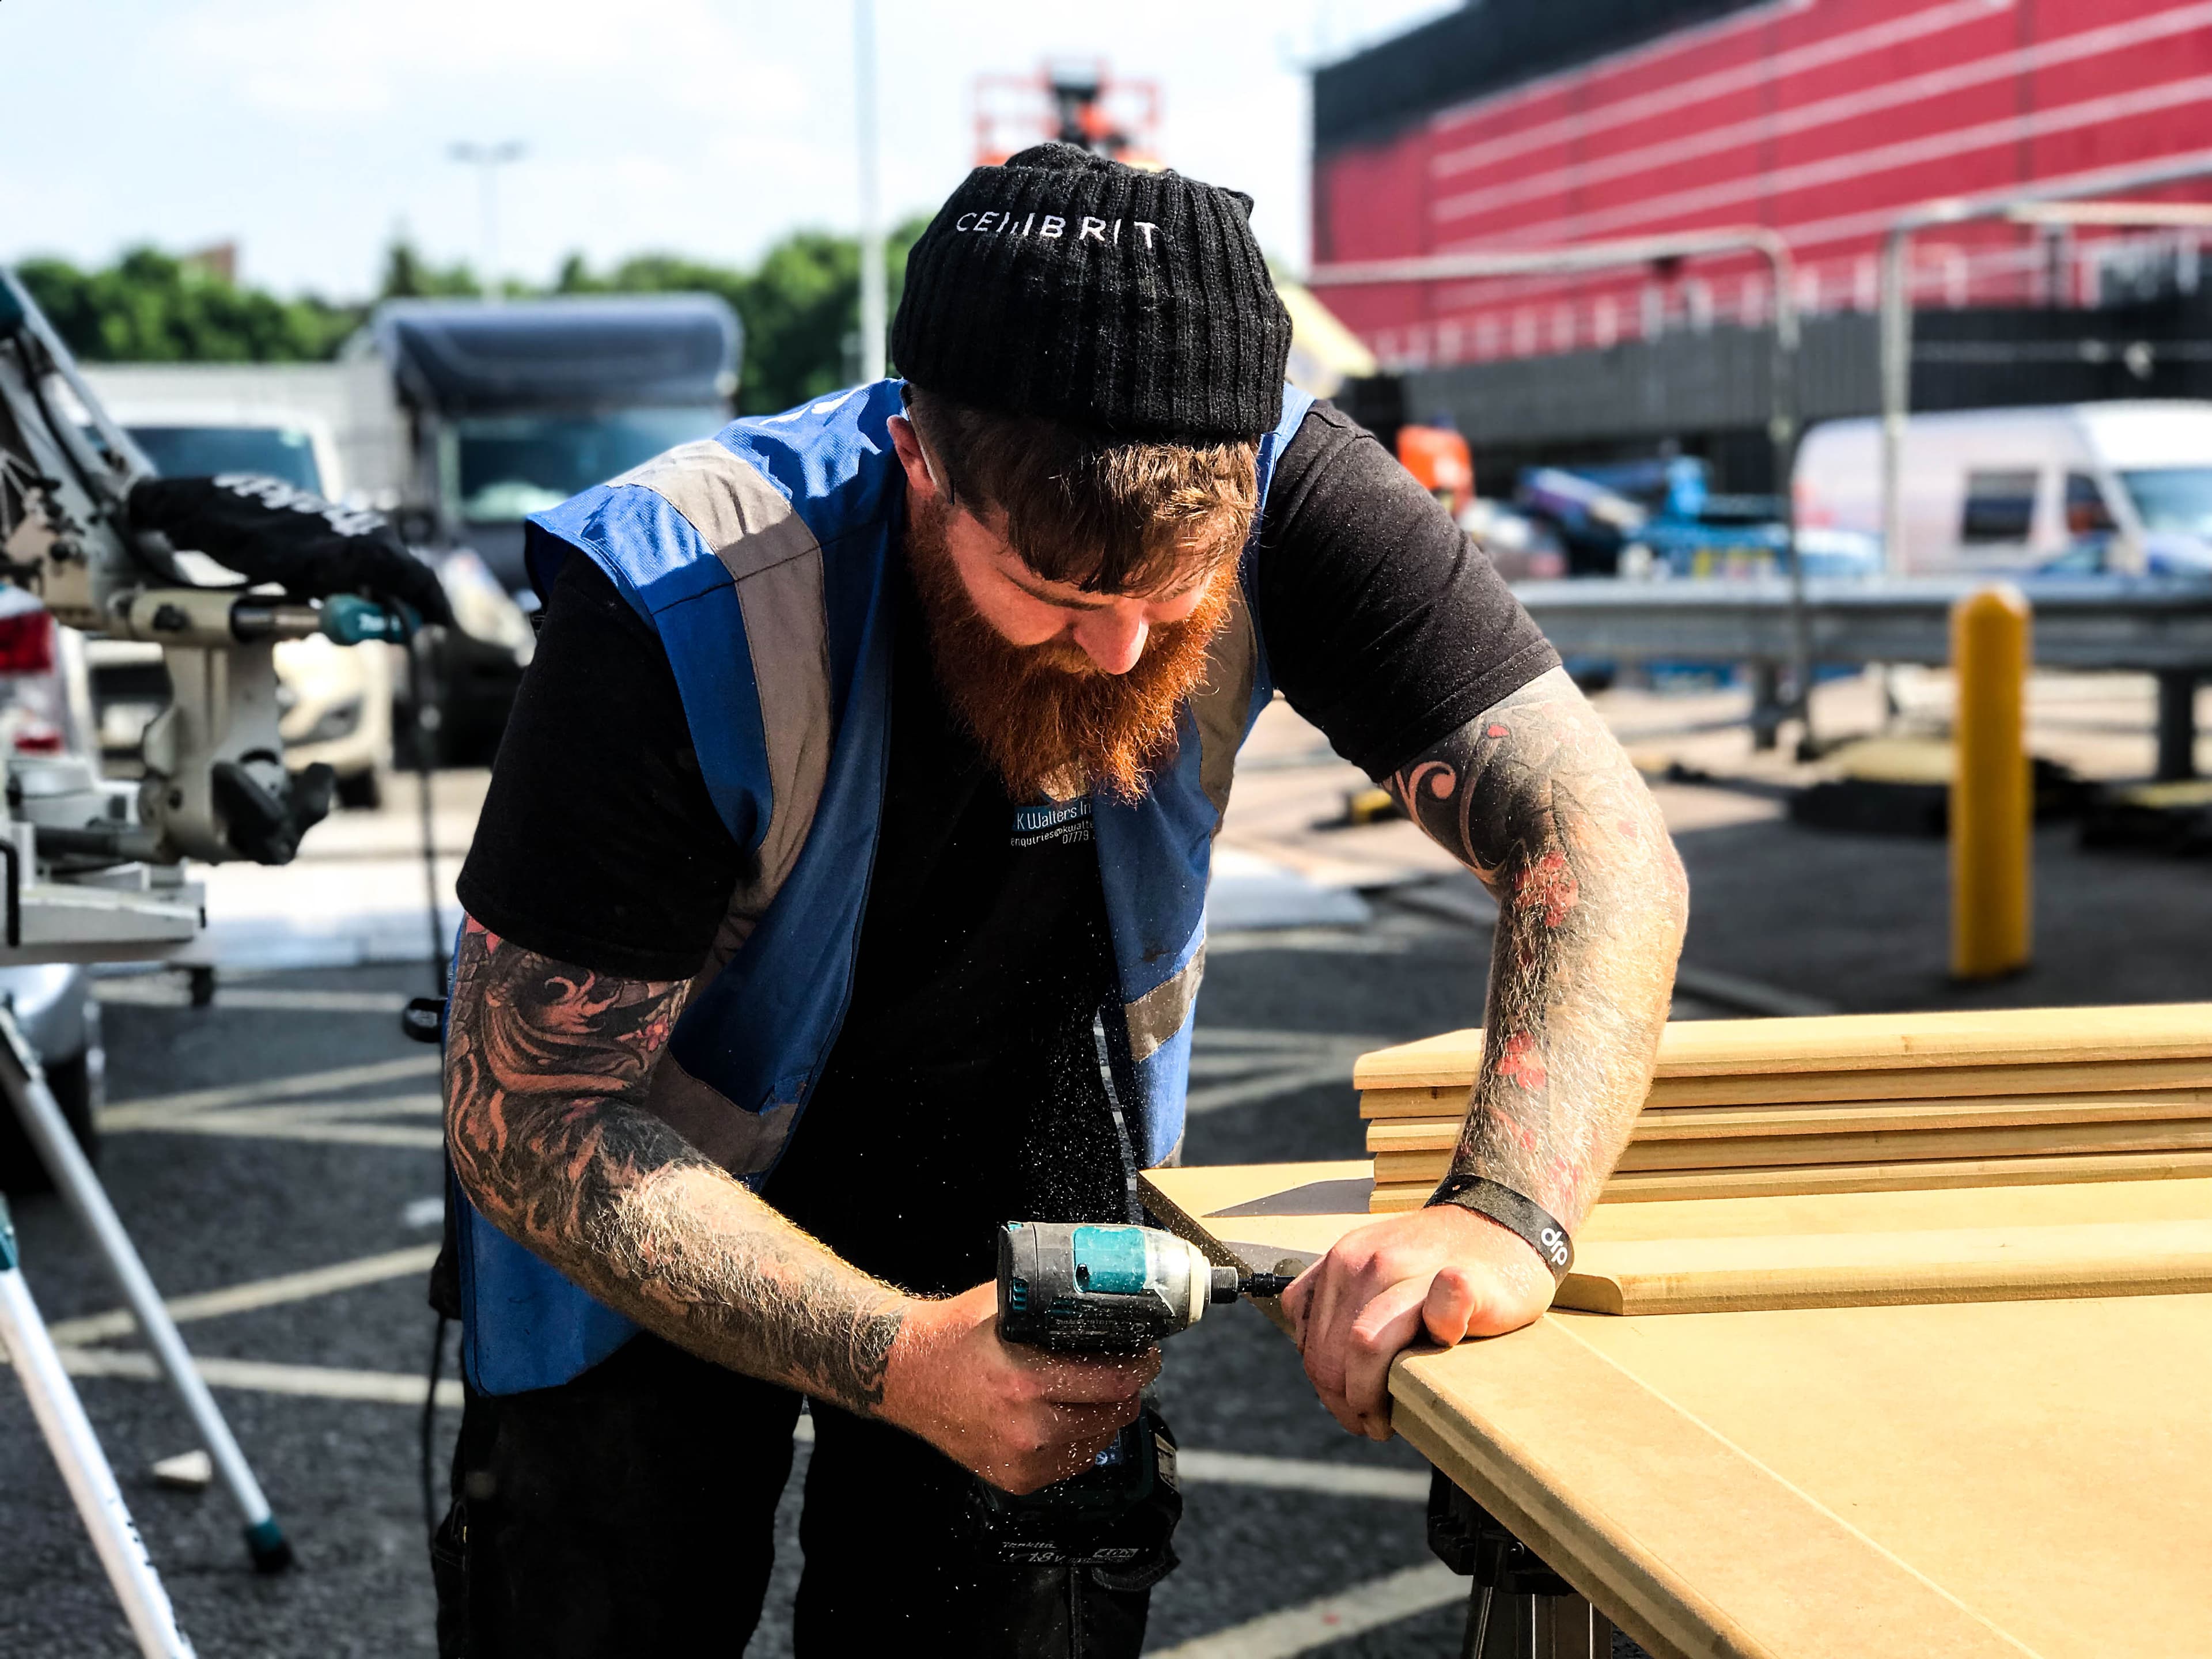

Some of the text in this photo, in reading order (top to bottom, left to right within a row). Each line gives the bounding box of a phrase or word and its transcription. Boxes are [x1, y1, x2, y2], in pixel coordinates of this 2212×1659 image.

[1017, 812, 1025, 830] K
[1027, 807, 1077, 830] Walters
[1541, 1228, 1567, 1266] drp
